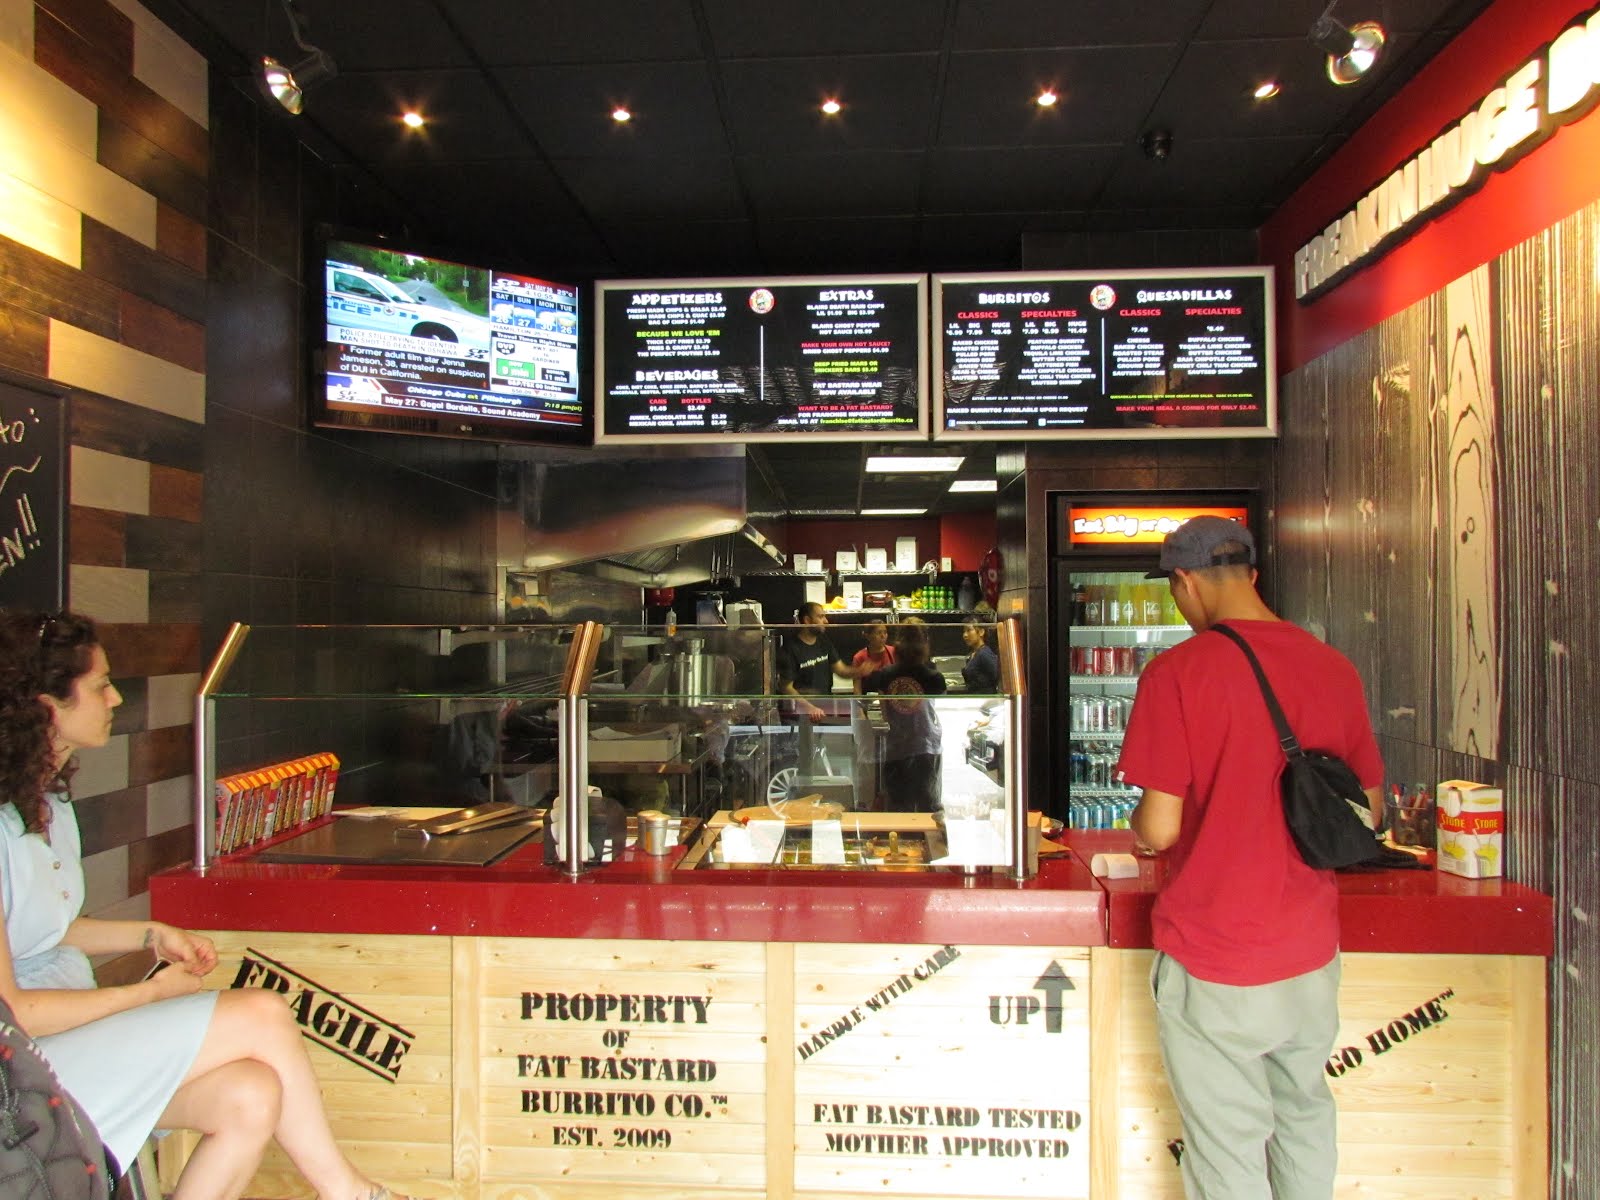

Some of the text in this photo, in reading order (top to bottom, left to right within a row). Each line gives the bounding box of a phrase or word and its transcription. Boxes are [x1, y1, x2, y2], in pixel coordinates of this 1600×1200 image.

[632, 293, 723, 305] APPETIZERS
[819, 290, 874, 301] EXTRAS
[978, 292, 1050, 304] BURRITOS
[1136, 290, 1232, 303] QUESADILLAS
[518, 318, 531, 326] 27
[957, 310, 1077, 319] CLASSICS SPECIALTIES
[340, 328, 365, 337] POLICE
[389, 335, 414, 344] TRYING
[340, 335, 358, 343] MAN
[393, 342, 416, 350] DEATH
[350, 346, 466, 368] Former adult film star Jenna
[340, 363, 350, 371] of
[351, 365, 368, 373] DUI
[400, 362, 434, 373] arrested
[448, 368, 486, 379] suspicion
[635, 369, 719, 381] BEVERAGES
[408, 386, 466, 399] Chicago Cubs
[385, 396, 403, 406] May
[405, 397, 418, 406] 27:
[420, 399, 444, 411] Gogol
[482, 405, 505, 416] Sound
[506, 408, 541, 420] Academy
[1104, 514, 1139, 537] Big
[1141, 518, 1157, 532] or
[1474, 818, 1499, 830] STONE
[520, 991, 713, 1024] PROPERTY
[797, 943, 962, 1061] HANDLE WITH CARE
[988, 995, 1041, 1025] UP
[602, 1029, 630, 1048] OF
[517, 1054, 717, 1083] FAT BASTARD
[1325, 1046, 1363, 1078] GO
[521, 1089, 656, 1117] BURRITO
[812, 1103, 1082, 1130] FAT BASTARD TESTED
[552, 1126, 672, 1149] EST. 2009
[825, 1133, 1070, 1159] MOTHER APPROVED
